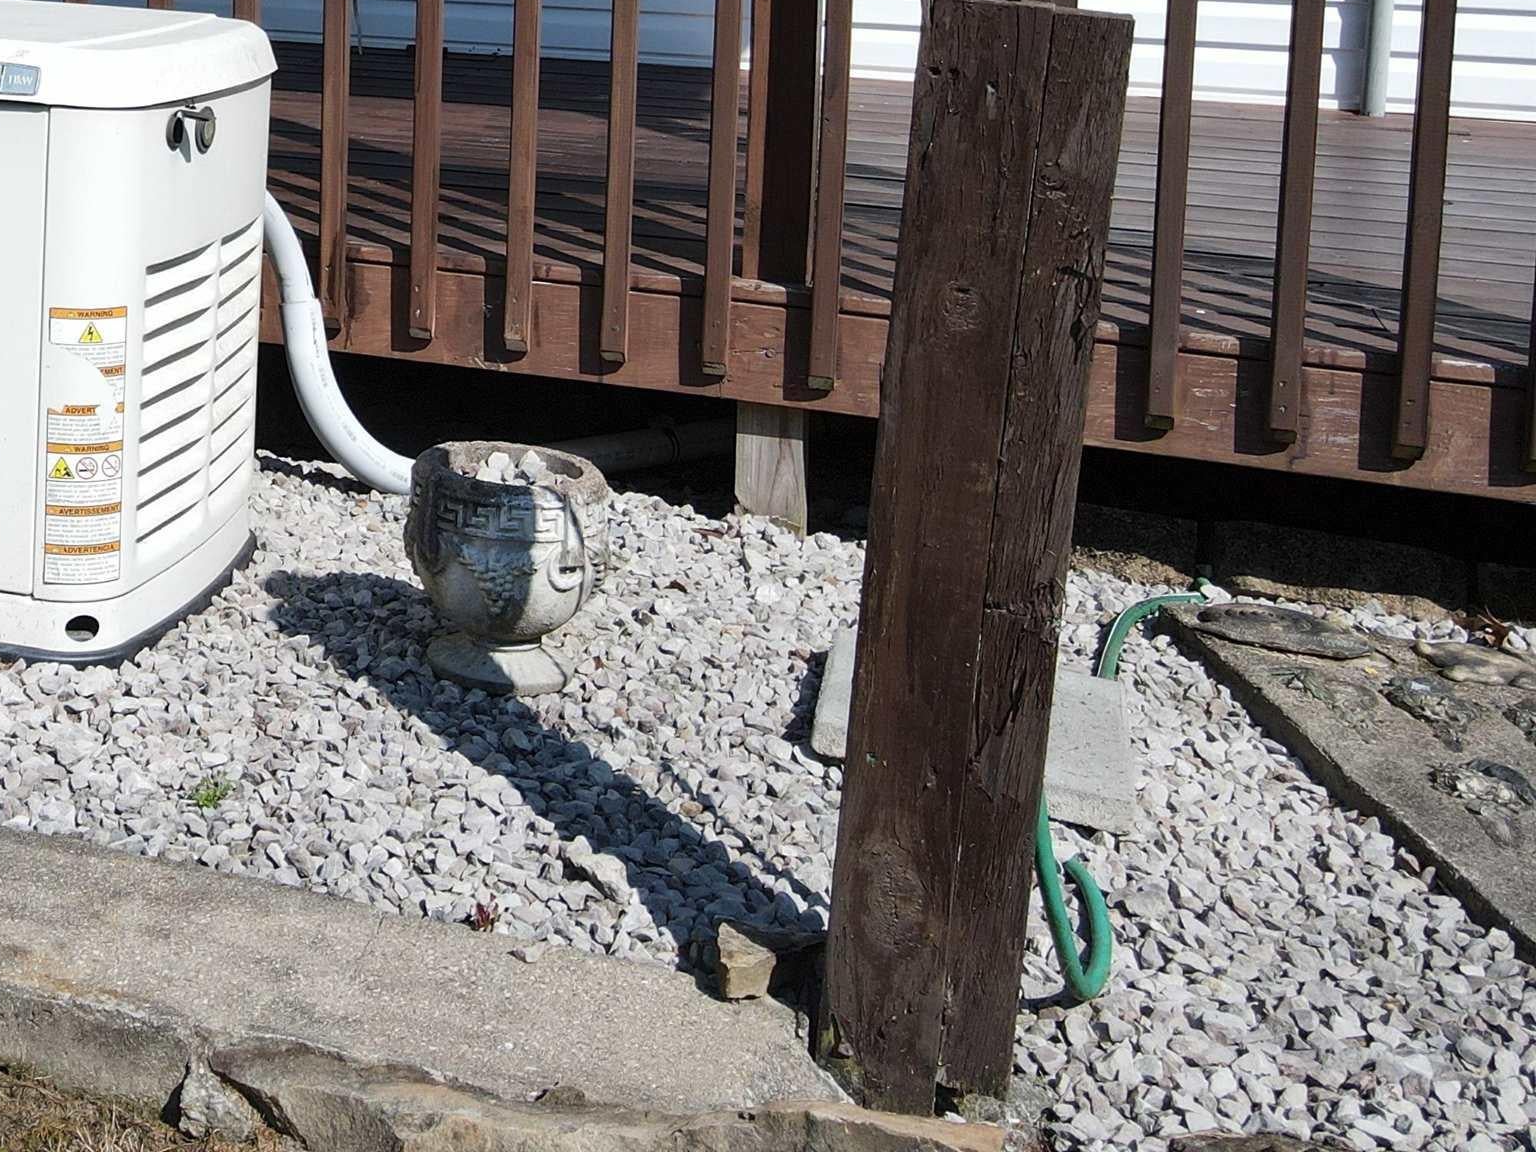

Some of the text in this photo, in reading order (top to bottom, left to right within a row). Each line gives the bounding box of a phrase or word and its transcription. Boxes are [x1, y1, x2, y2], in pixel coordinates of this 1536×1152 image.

[76, 310, 113, 318] WARNING
[74, 445, 110, 453] WARNING
[59, 504, 120, 515] AVERTISSEMENT
[63, 544, 115, 554] ADVERTENCIA
